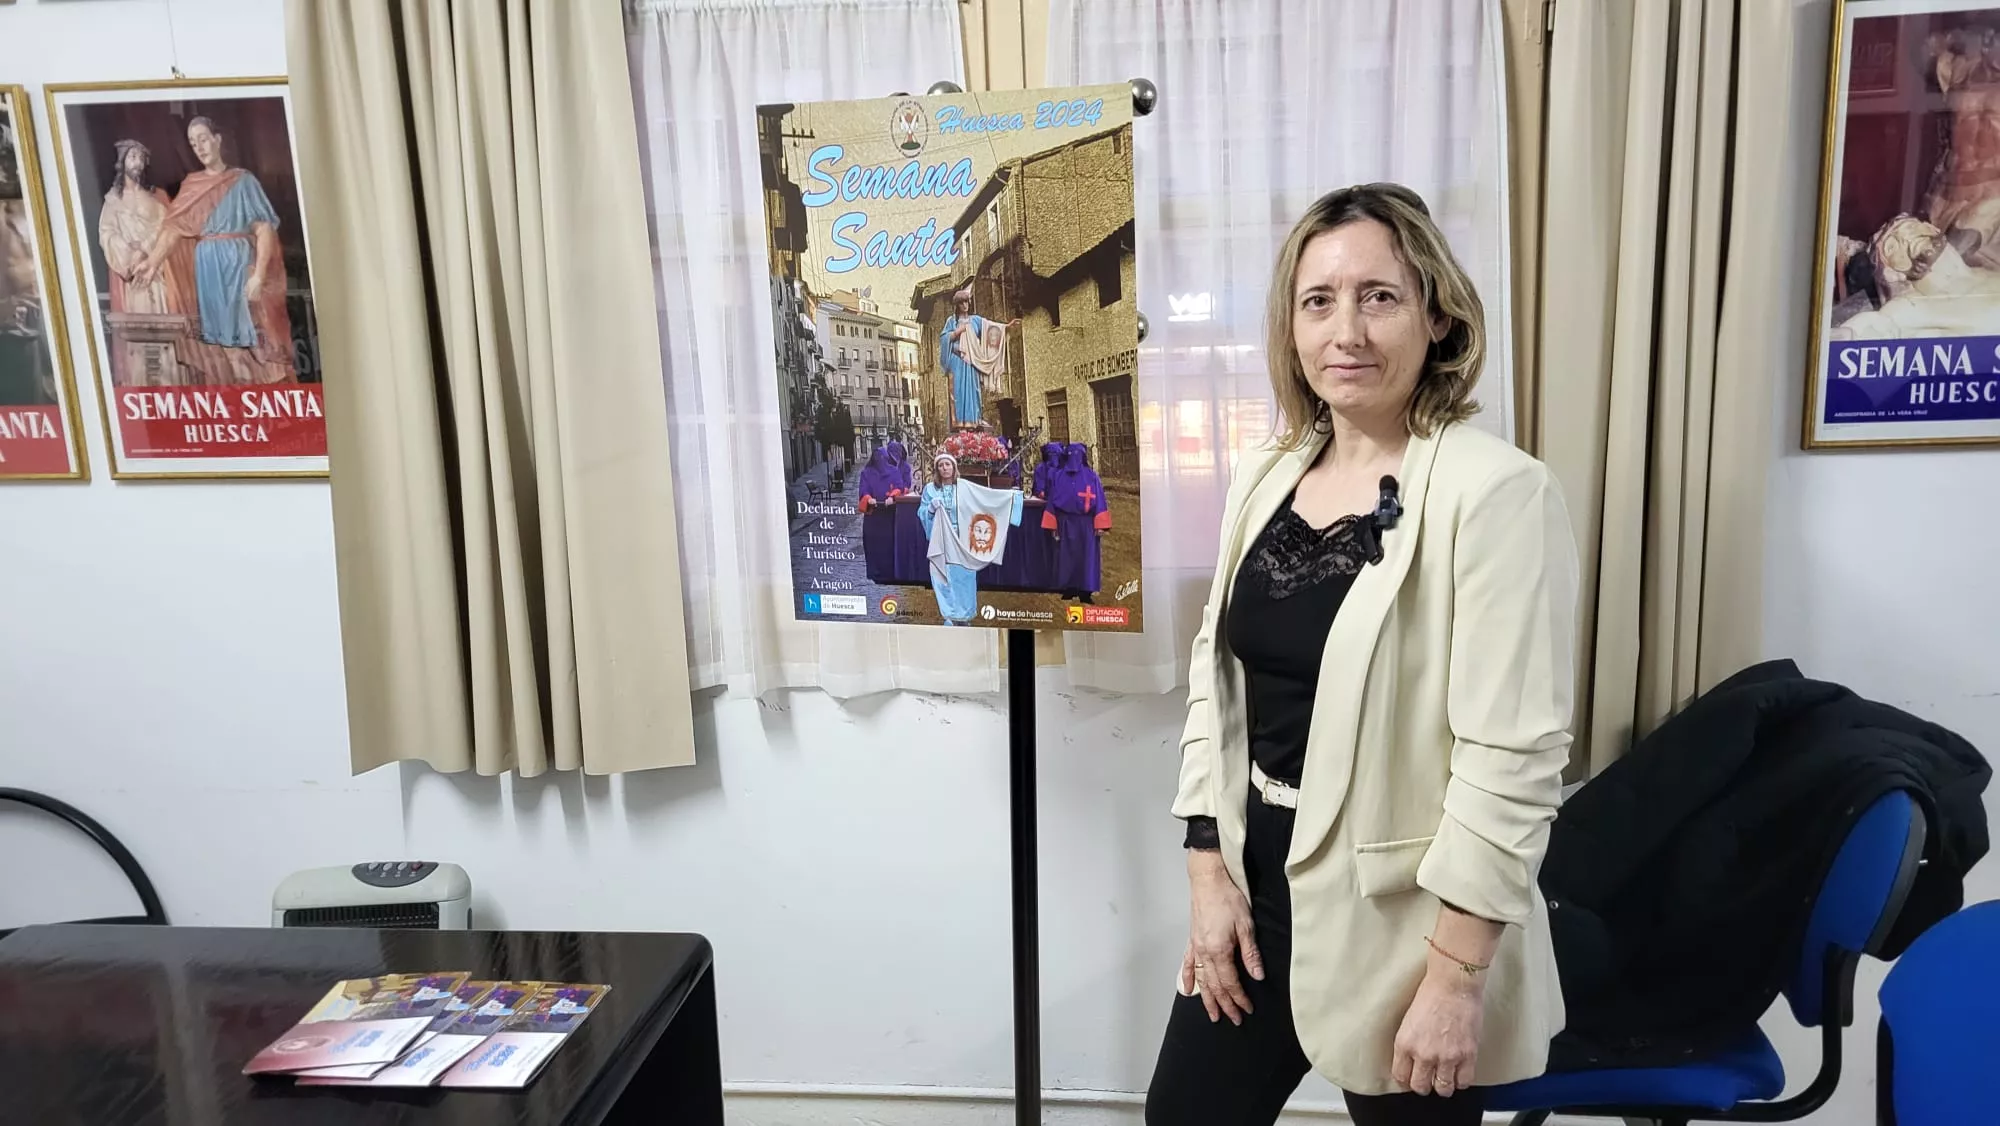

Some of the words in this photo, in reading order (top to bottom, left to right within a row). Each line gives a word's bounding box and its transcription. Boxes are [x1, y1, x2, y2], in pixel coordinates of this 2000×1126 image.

[934, 105, 1024, 134] Huesca
[1033, 98, 1104, 129] 2024
[801, 144, 977, 208] Semana
[825, 211, 960, 274] Santa
[1096, 358, 1105, 377] DE
[1838, 344, 1974, 379] SEMANA
[123, 391, 230, 421] SEMANA
[241, 390, 323, 419] SANTA
[184, 423, 270, 444] HUESCA
[797, 501, 856, 515] Declarada
[819, 517, 835, 530] de
[808, 532, 848, 545] Interés
[803, 547, 856, 560] Turístico
[819, 562, 834, 575] de
[810, 577, 852, 592] Aragón
[996, 609, 1016, 618] hoya
[1026, 609, 1053, 619] huesca
[1096, 615, 1124, 623] HUESCA
